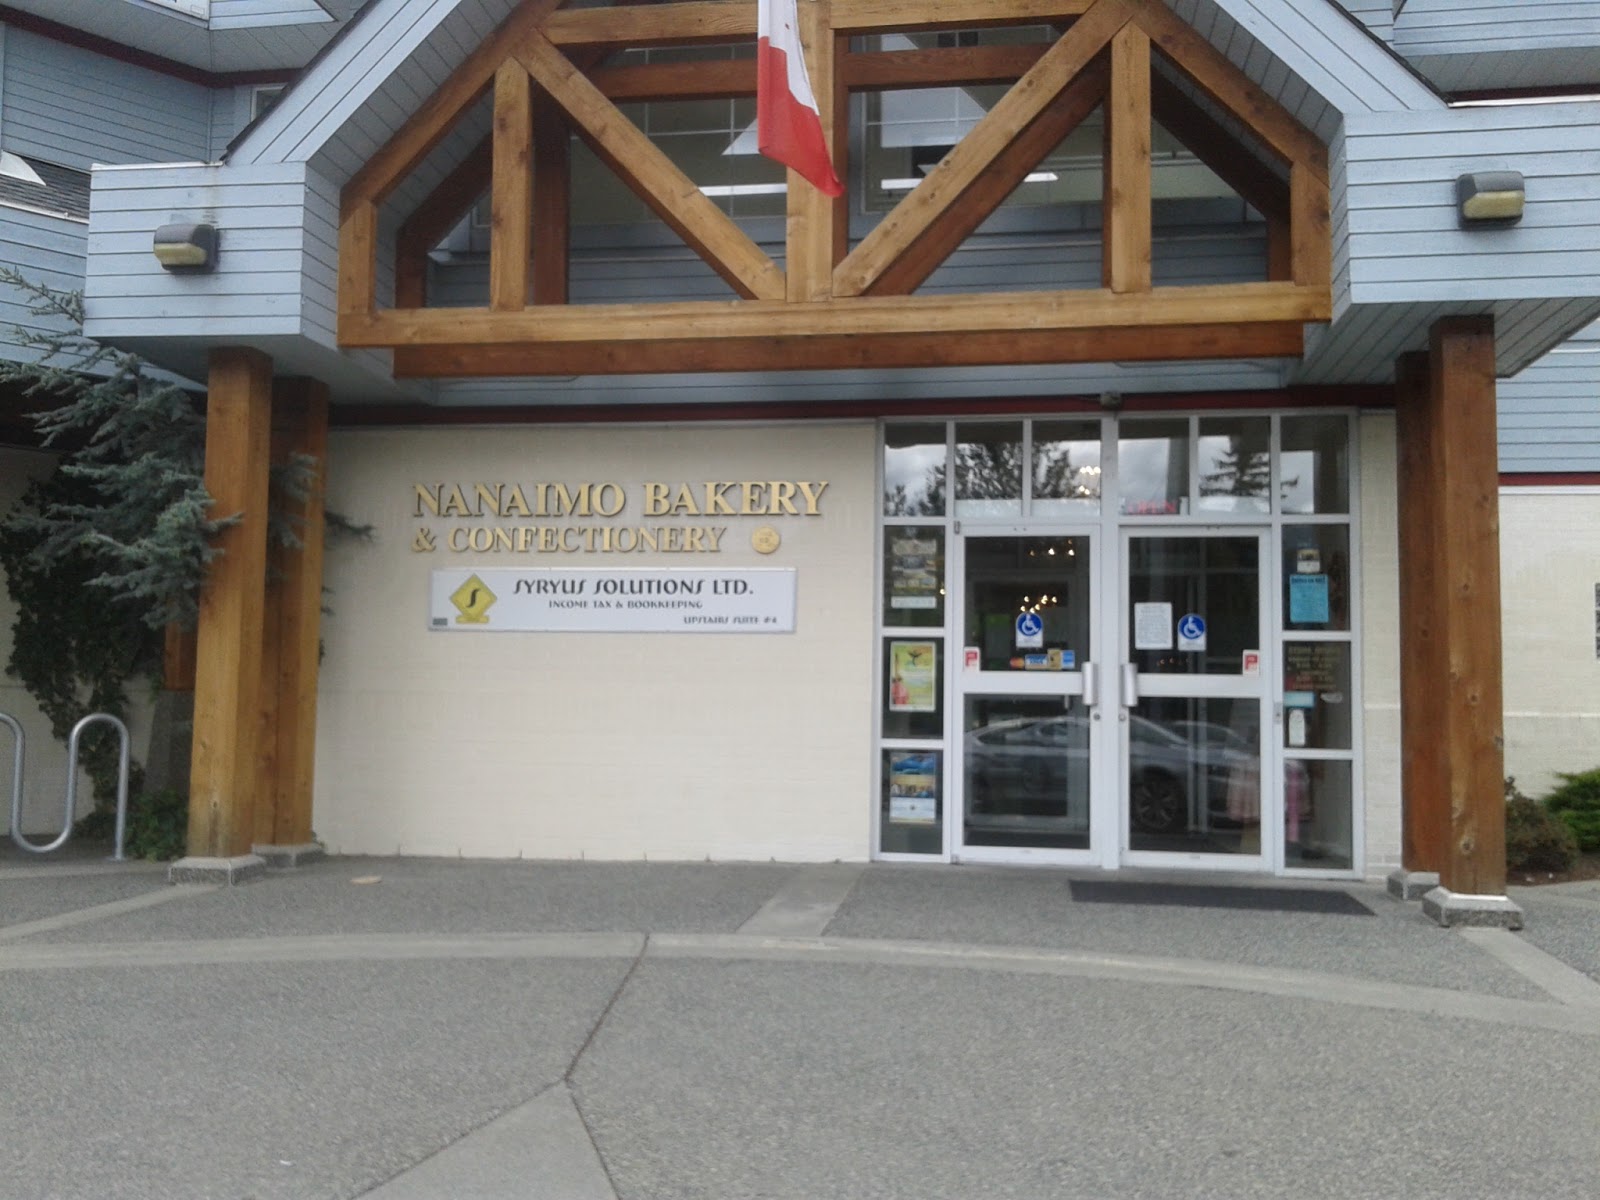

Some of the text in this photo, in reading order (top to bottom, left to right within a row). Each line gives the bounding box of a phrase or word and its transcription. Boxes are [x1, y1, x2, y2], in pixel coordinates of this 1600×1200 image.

[413, 481, 829, 517] NANAIMO BAKERY
[411, 526, 727, 553] & CONFECTIONERY
[513, 579, 754, 595] SYRYUS SOLUTIONS LTD.
[549, 600, 588, 609] INCOME
[593, 600, 612, 609] TAX
[615, 600, 624, 609] &
